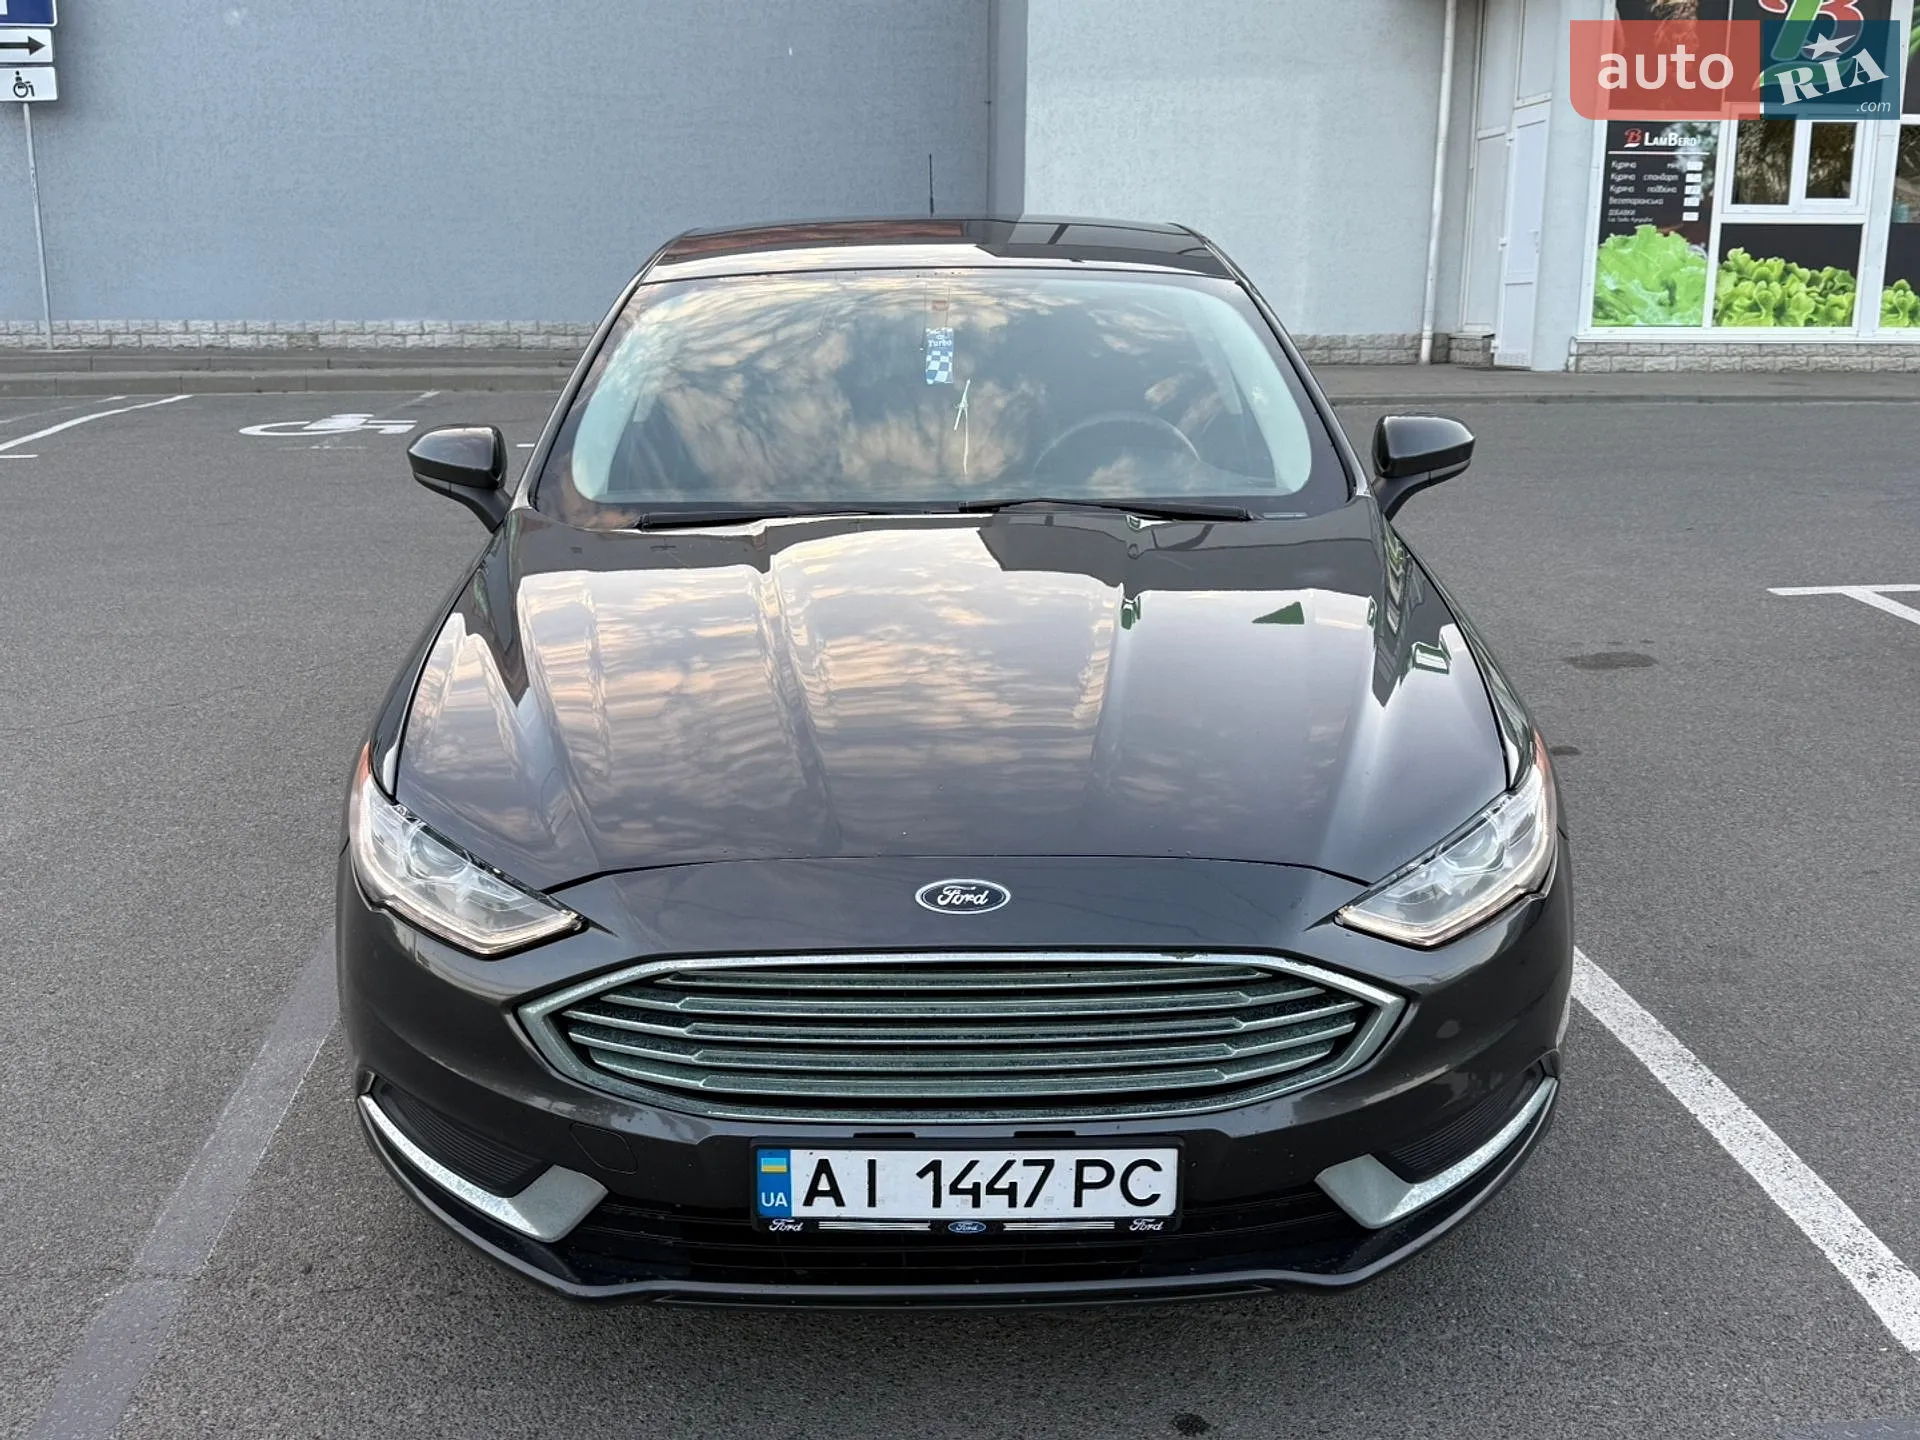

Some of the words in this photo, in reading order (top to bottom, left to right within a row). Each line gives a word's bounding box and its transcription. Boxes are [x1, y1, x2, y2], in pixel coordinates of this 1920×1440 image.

[937, 885, 990, 905] Ford
[915, 1158, 1055, 1208] 1447
[1073, 1158, 1163, 1208] PC
[761, 1191, 788, 1208] UA
[768, 1218, 803, 1232] Ford
[955, 1221, 979, 1232] Ford
[1129, 1218, 1163, 1232] Ford
